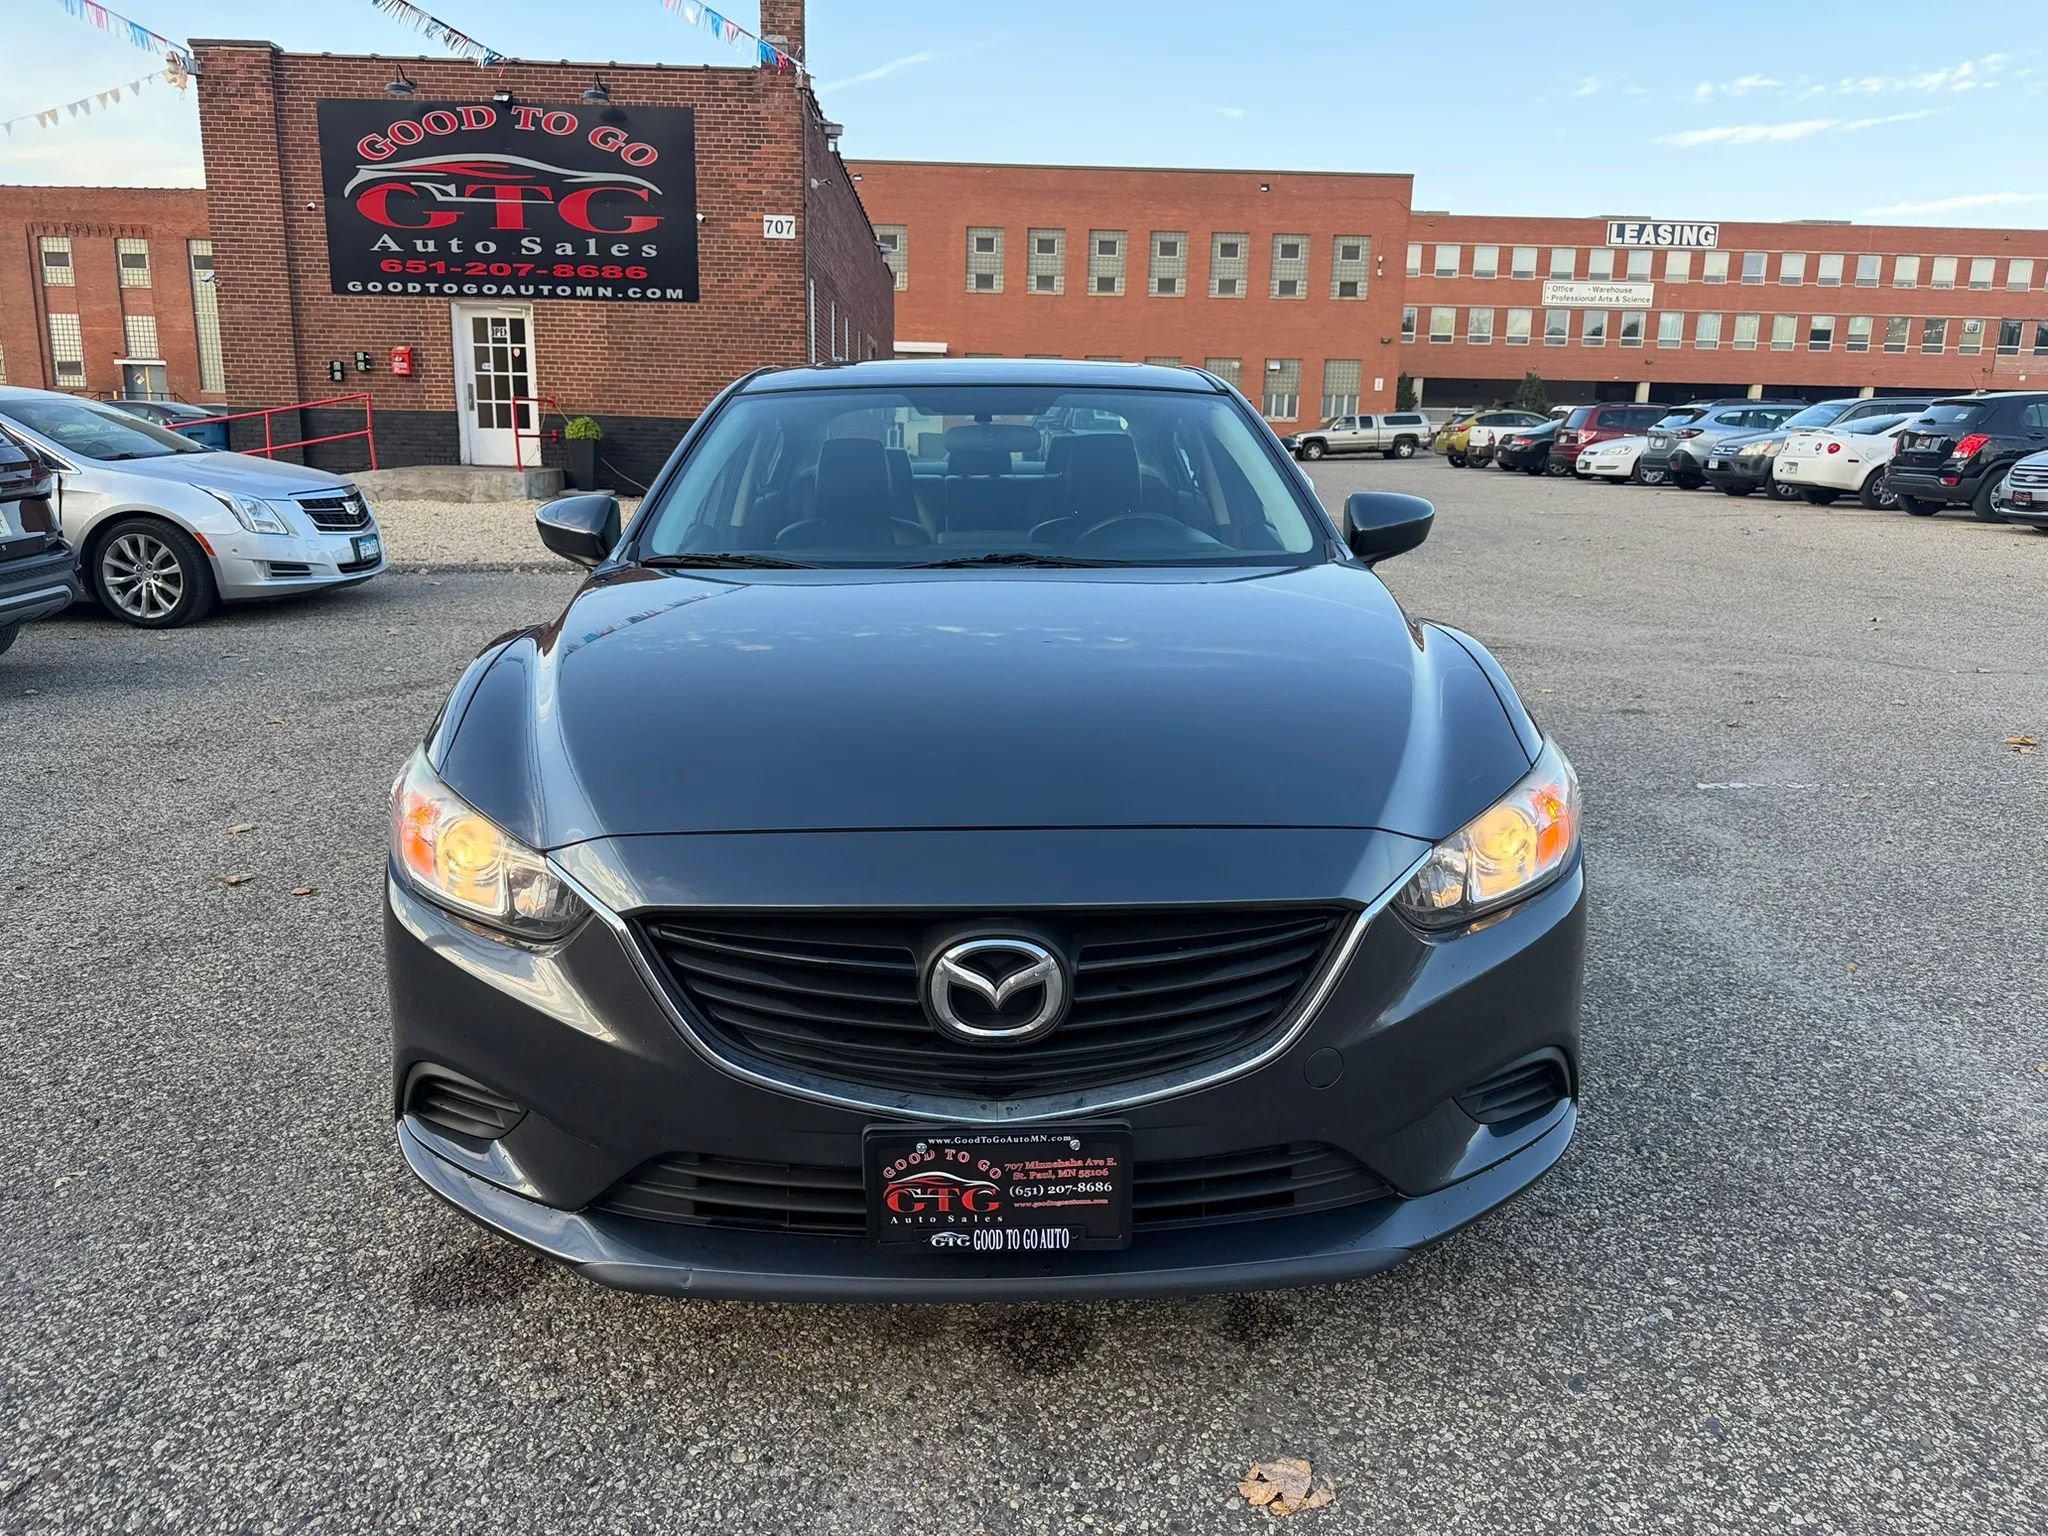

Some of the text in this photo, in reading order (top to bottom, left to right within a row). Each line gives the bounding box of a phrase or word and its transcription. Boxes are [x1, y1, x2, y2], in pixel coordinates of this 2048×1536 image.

[356, 105, 659, 167] GOOD TO GO
[355, 182, 665, 235] GTG
[765, 219, 794, 235] 707
[1609, 223, 1716, 247] LEASING
[369, 233, 659, 258] Auto Sales
[379, 258, 649, 281] 651-207-8686
[346, 280, 685, 301] GOODTOGOAUTOMN.COM
[1551, 294, 1597, 303] Professional
[1599, 295, 1613, 303] Arts
[1622, 296, 1651, 304] Science
[1552, 284, 1633, 294] Office Warehouse
[927, 1134, 1072, 1145] www.GoodToGoAutoMN.com
[882, 1148, 1002, 1180] GOOD TO GO
[1004, 1163, 1024, 1172] 707
[1084, 1157, 1105, 1167] Ave
[1106, 1157, 1118, 1167] E.
[1012, 1167, 1109, 1181] St. Paul, MN 55106
[886, 1187, 1002, 1213] GTG
[1009, 1181, 1113, 1198] (651) 207-8686
[890, 1213, 1003, 1225] Auto Sales
[973, 1229, 1004, 1251] GOOD
[1006, 1228, 1020, 1250] TO
[1023, 1228, 1038, 1250] GO
[1039, 1227, 1070, 1249] AUTO
